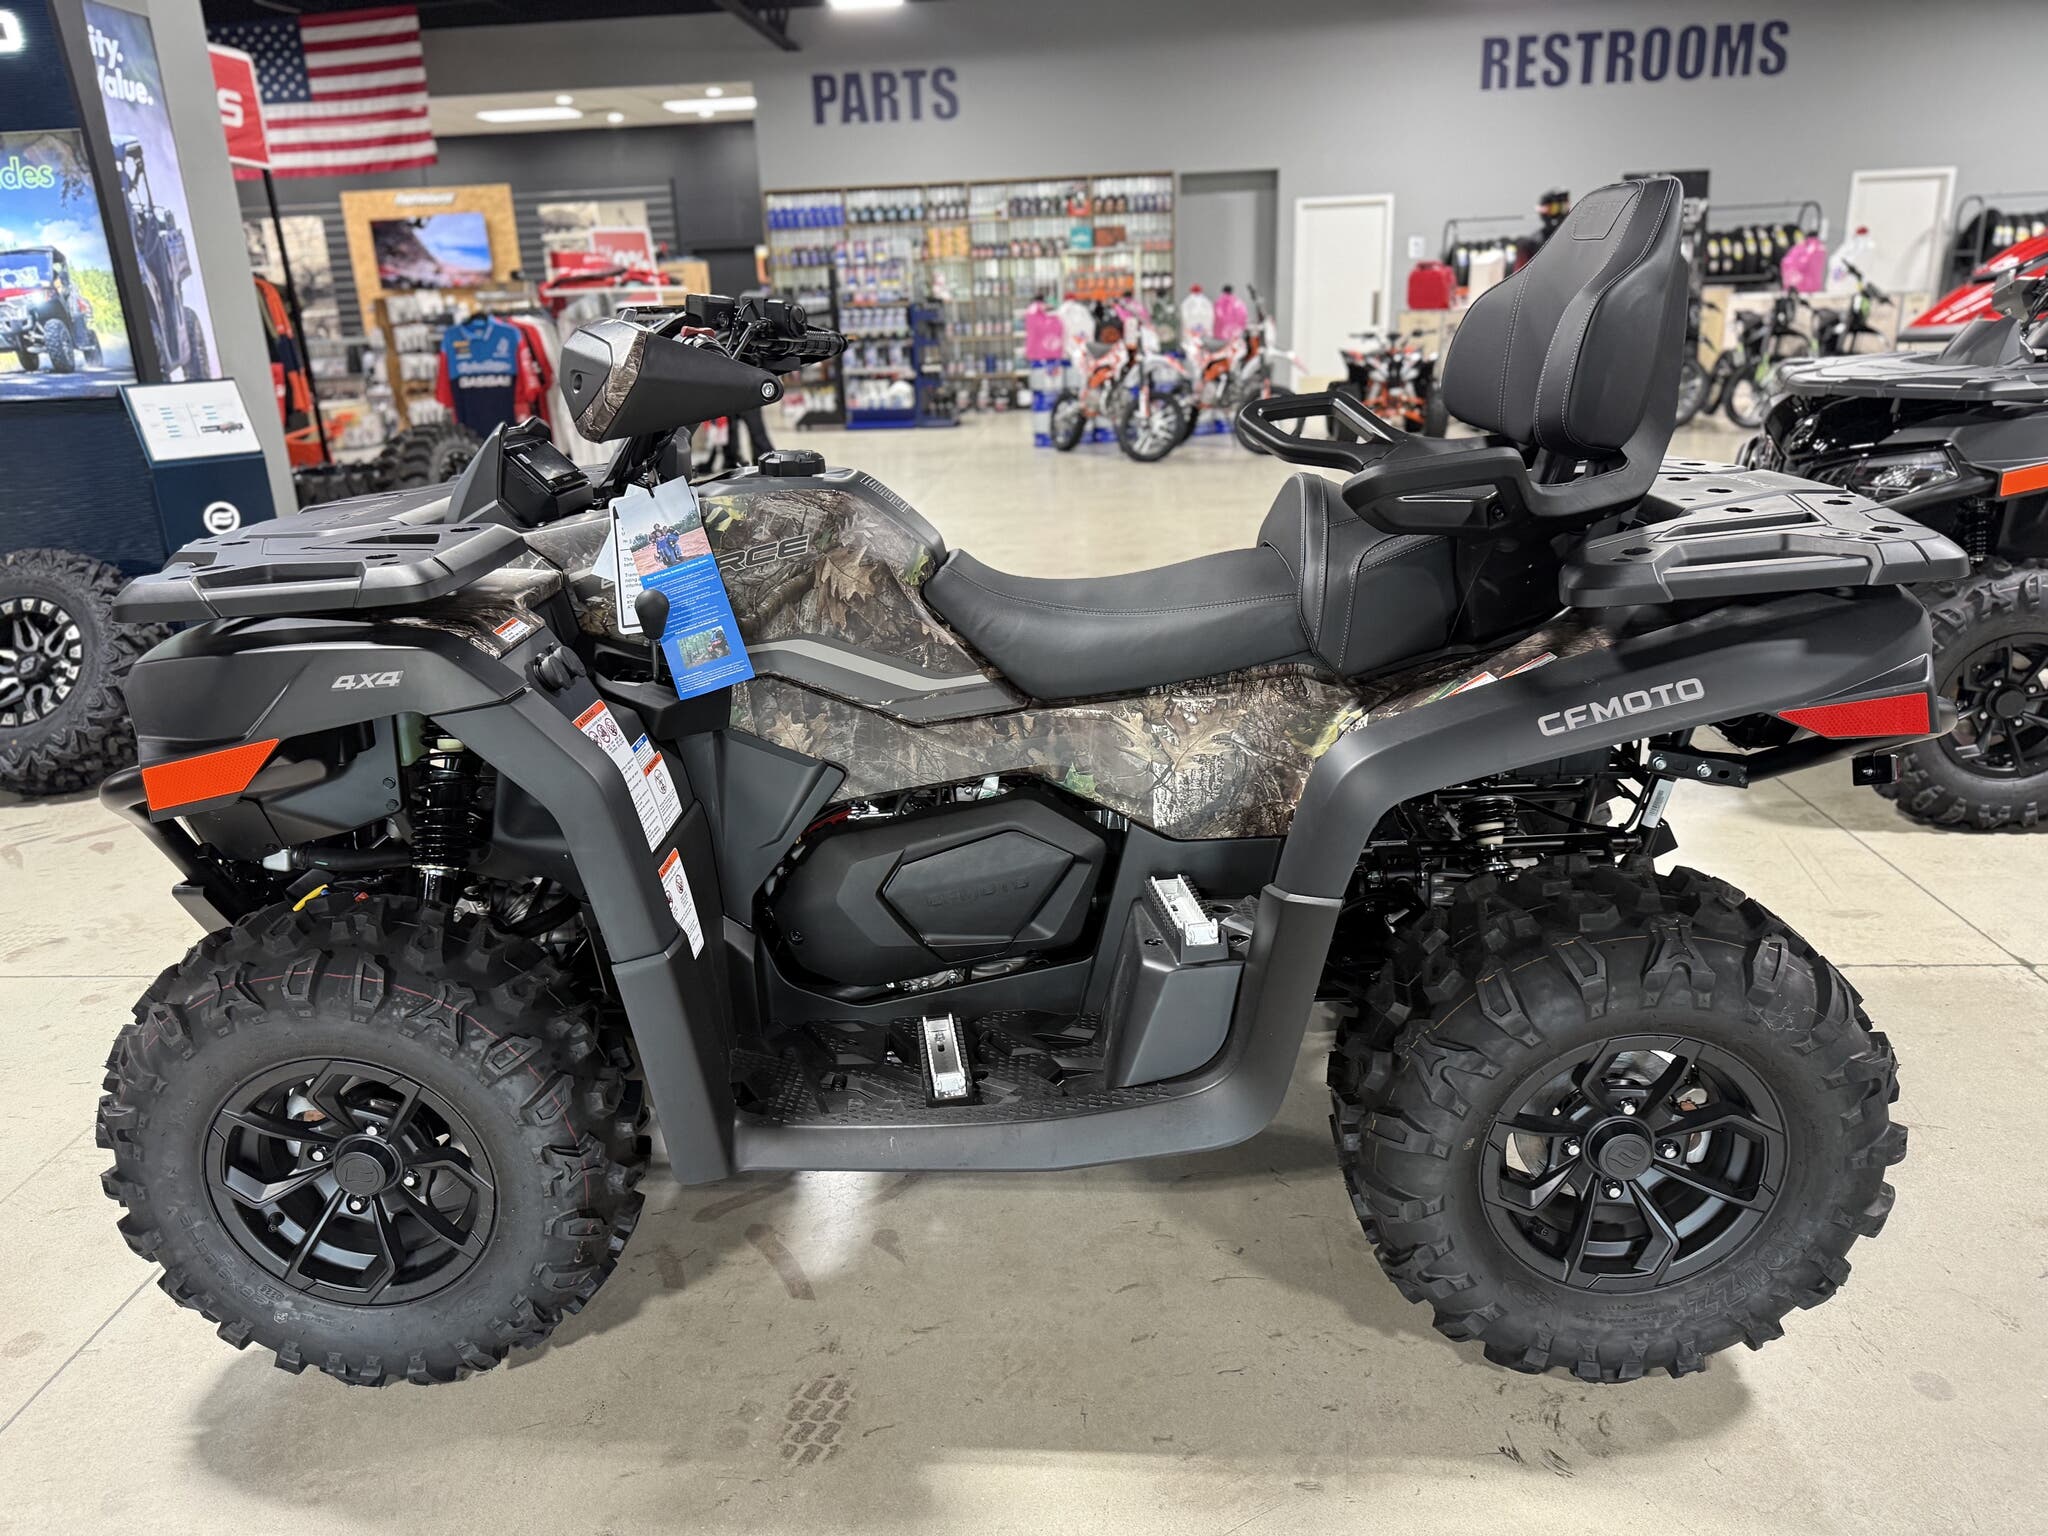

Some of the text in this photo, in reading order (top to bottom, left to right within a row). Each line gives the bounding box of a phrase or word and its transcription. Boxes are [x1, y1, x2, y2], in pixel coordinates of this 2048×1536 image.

[1481, 20, 1790, 90] RESTROOMS
[811, 66, 959, 126] PARTS
[1537, 677, 1705, 737] CFMOTO
